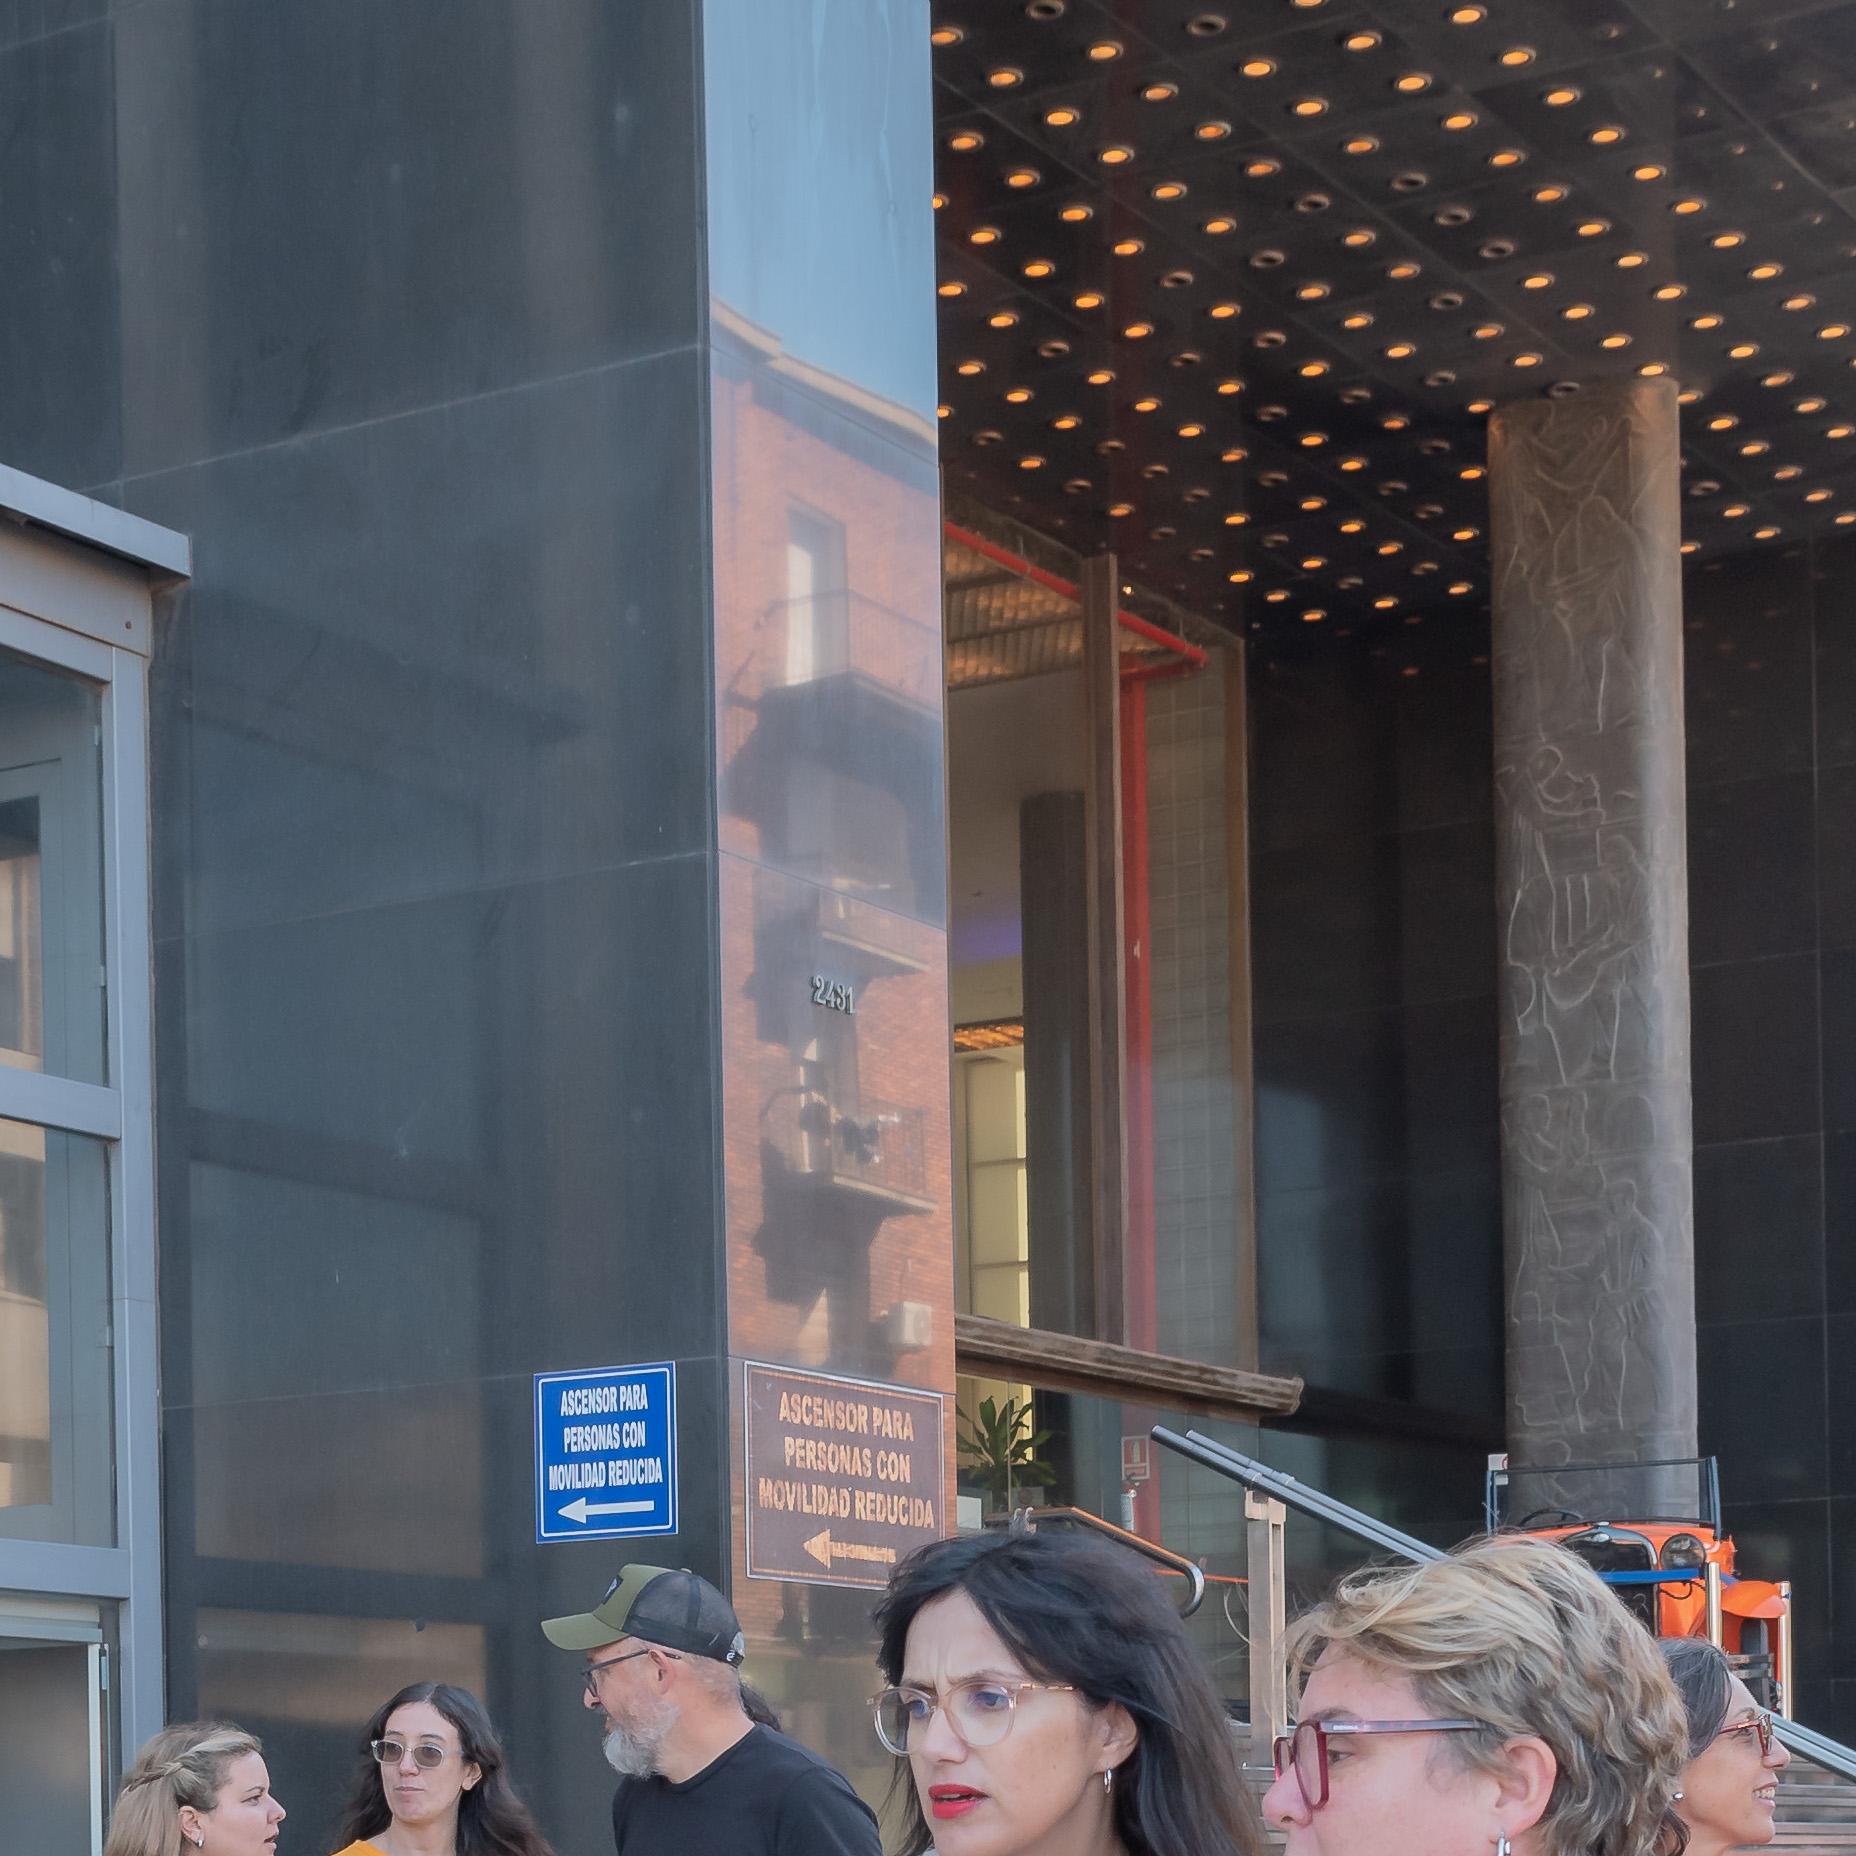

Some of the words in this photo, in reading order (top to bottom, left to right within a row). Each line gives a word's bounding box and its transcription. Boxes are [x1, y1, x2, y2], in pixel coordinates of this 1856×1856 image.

[560, 1386, 618, 1417] ASCENSOR
[619, 1384, 648, 1411] PARA
[778, 1391, 868, 1435] ASCENSOR
[872, 1407, 914, 1441] PARA
[564, 1423, 620, 1453] PERSONAS
[622, 1421, 646, 1448] CON
[549, 1462, 606, 1491] MOVILIDAD
[608, 1457, 663, 1487] REDUCIDA
[784, 1436, 872, 1478] PERSONAS
[876, 1450, 911, 1483] CON
[758, 1477, 851, 1518] MOVILIDAD
[854, 1489, 935, 1529] REDUCIDA
